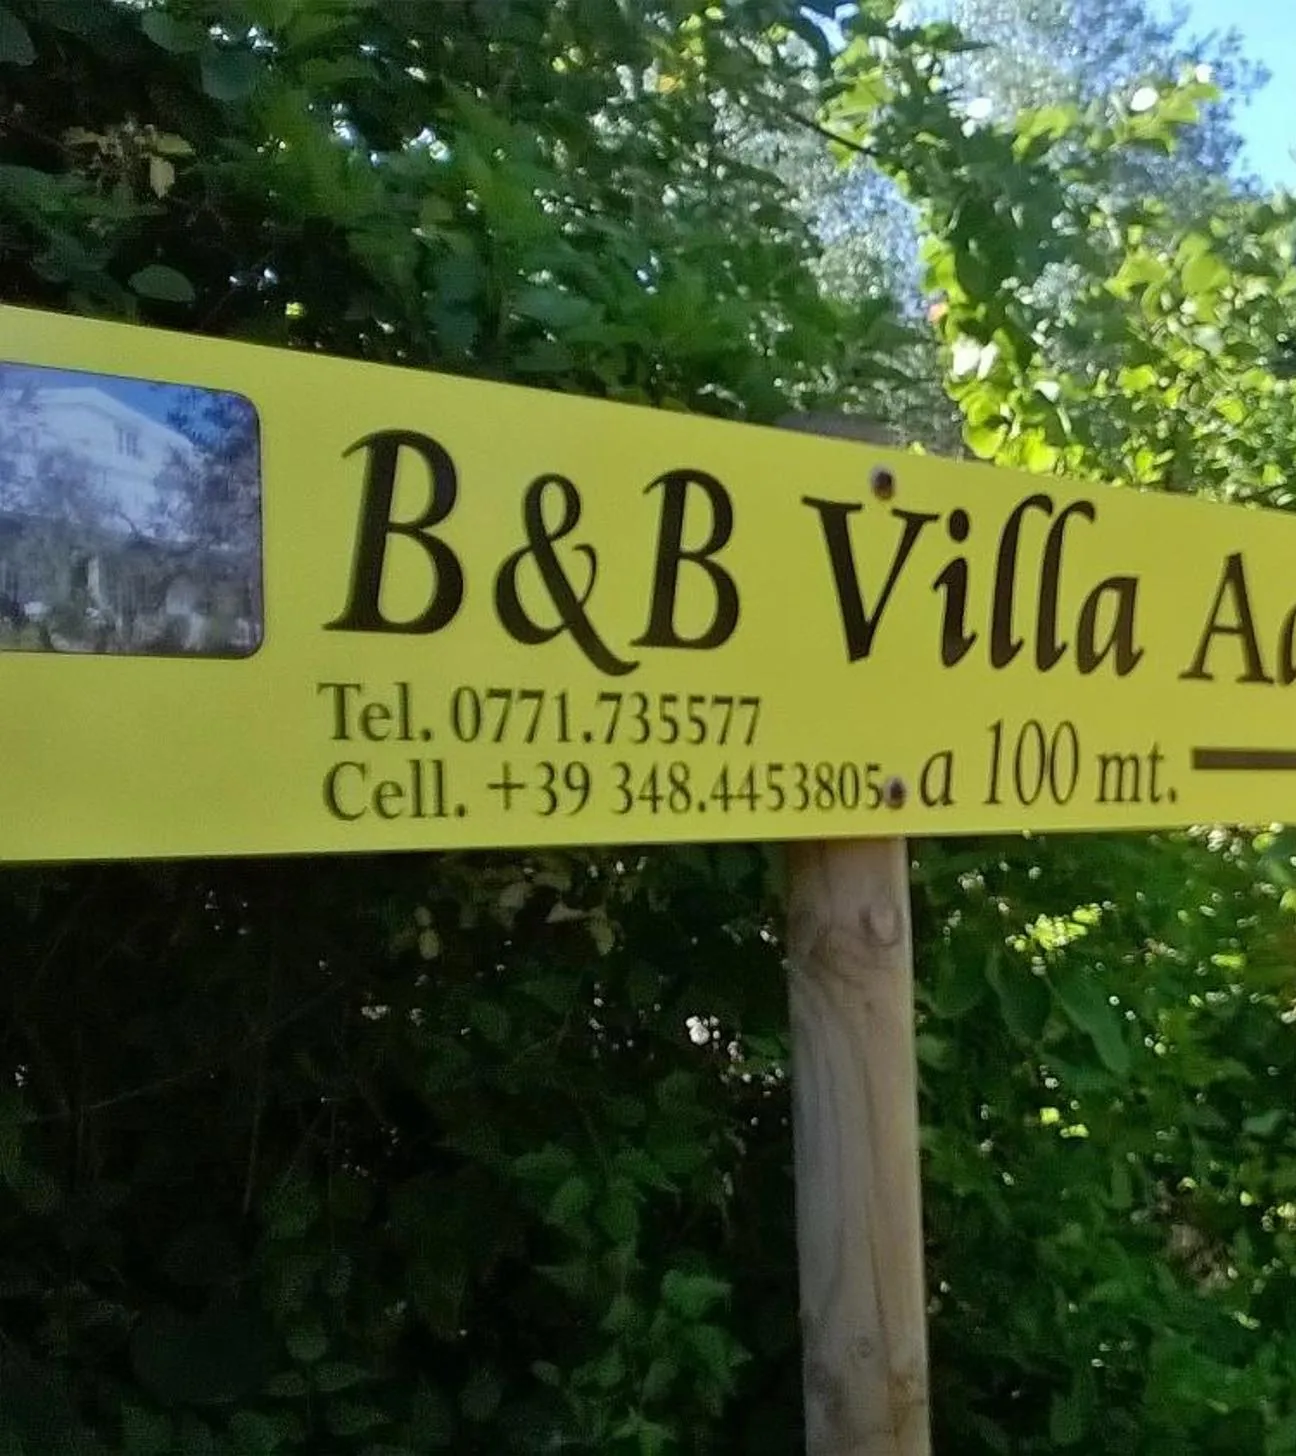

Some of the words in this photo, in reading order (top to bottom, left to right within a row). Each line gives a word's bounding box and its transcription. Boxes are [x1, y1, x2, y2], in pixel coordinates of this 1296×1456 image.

[321, 428, 741, 676] B&B
[801, 493, 1144, 677] Villa
[317, 681, 433, 743] Tel.
[451, 686, 762, 746] 0771.735577
[321, 758, 468, 821] Cell.
[486, 761, 592, 816] +39
[611, 760, 882, 815] 348.4453805
[919, 748, 954, 808] a
[982, 718, 1080, 806] 100
[1096, 740, 1178, 804] mt.
